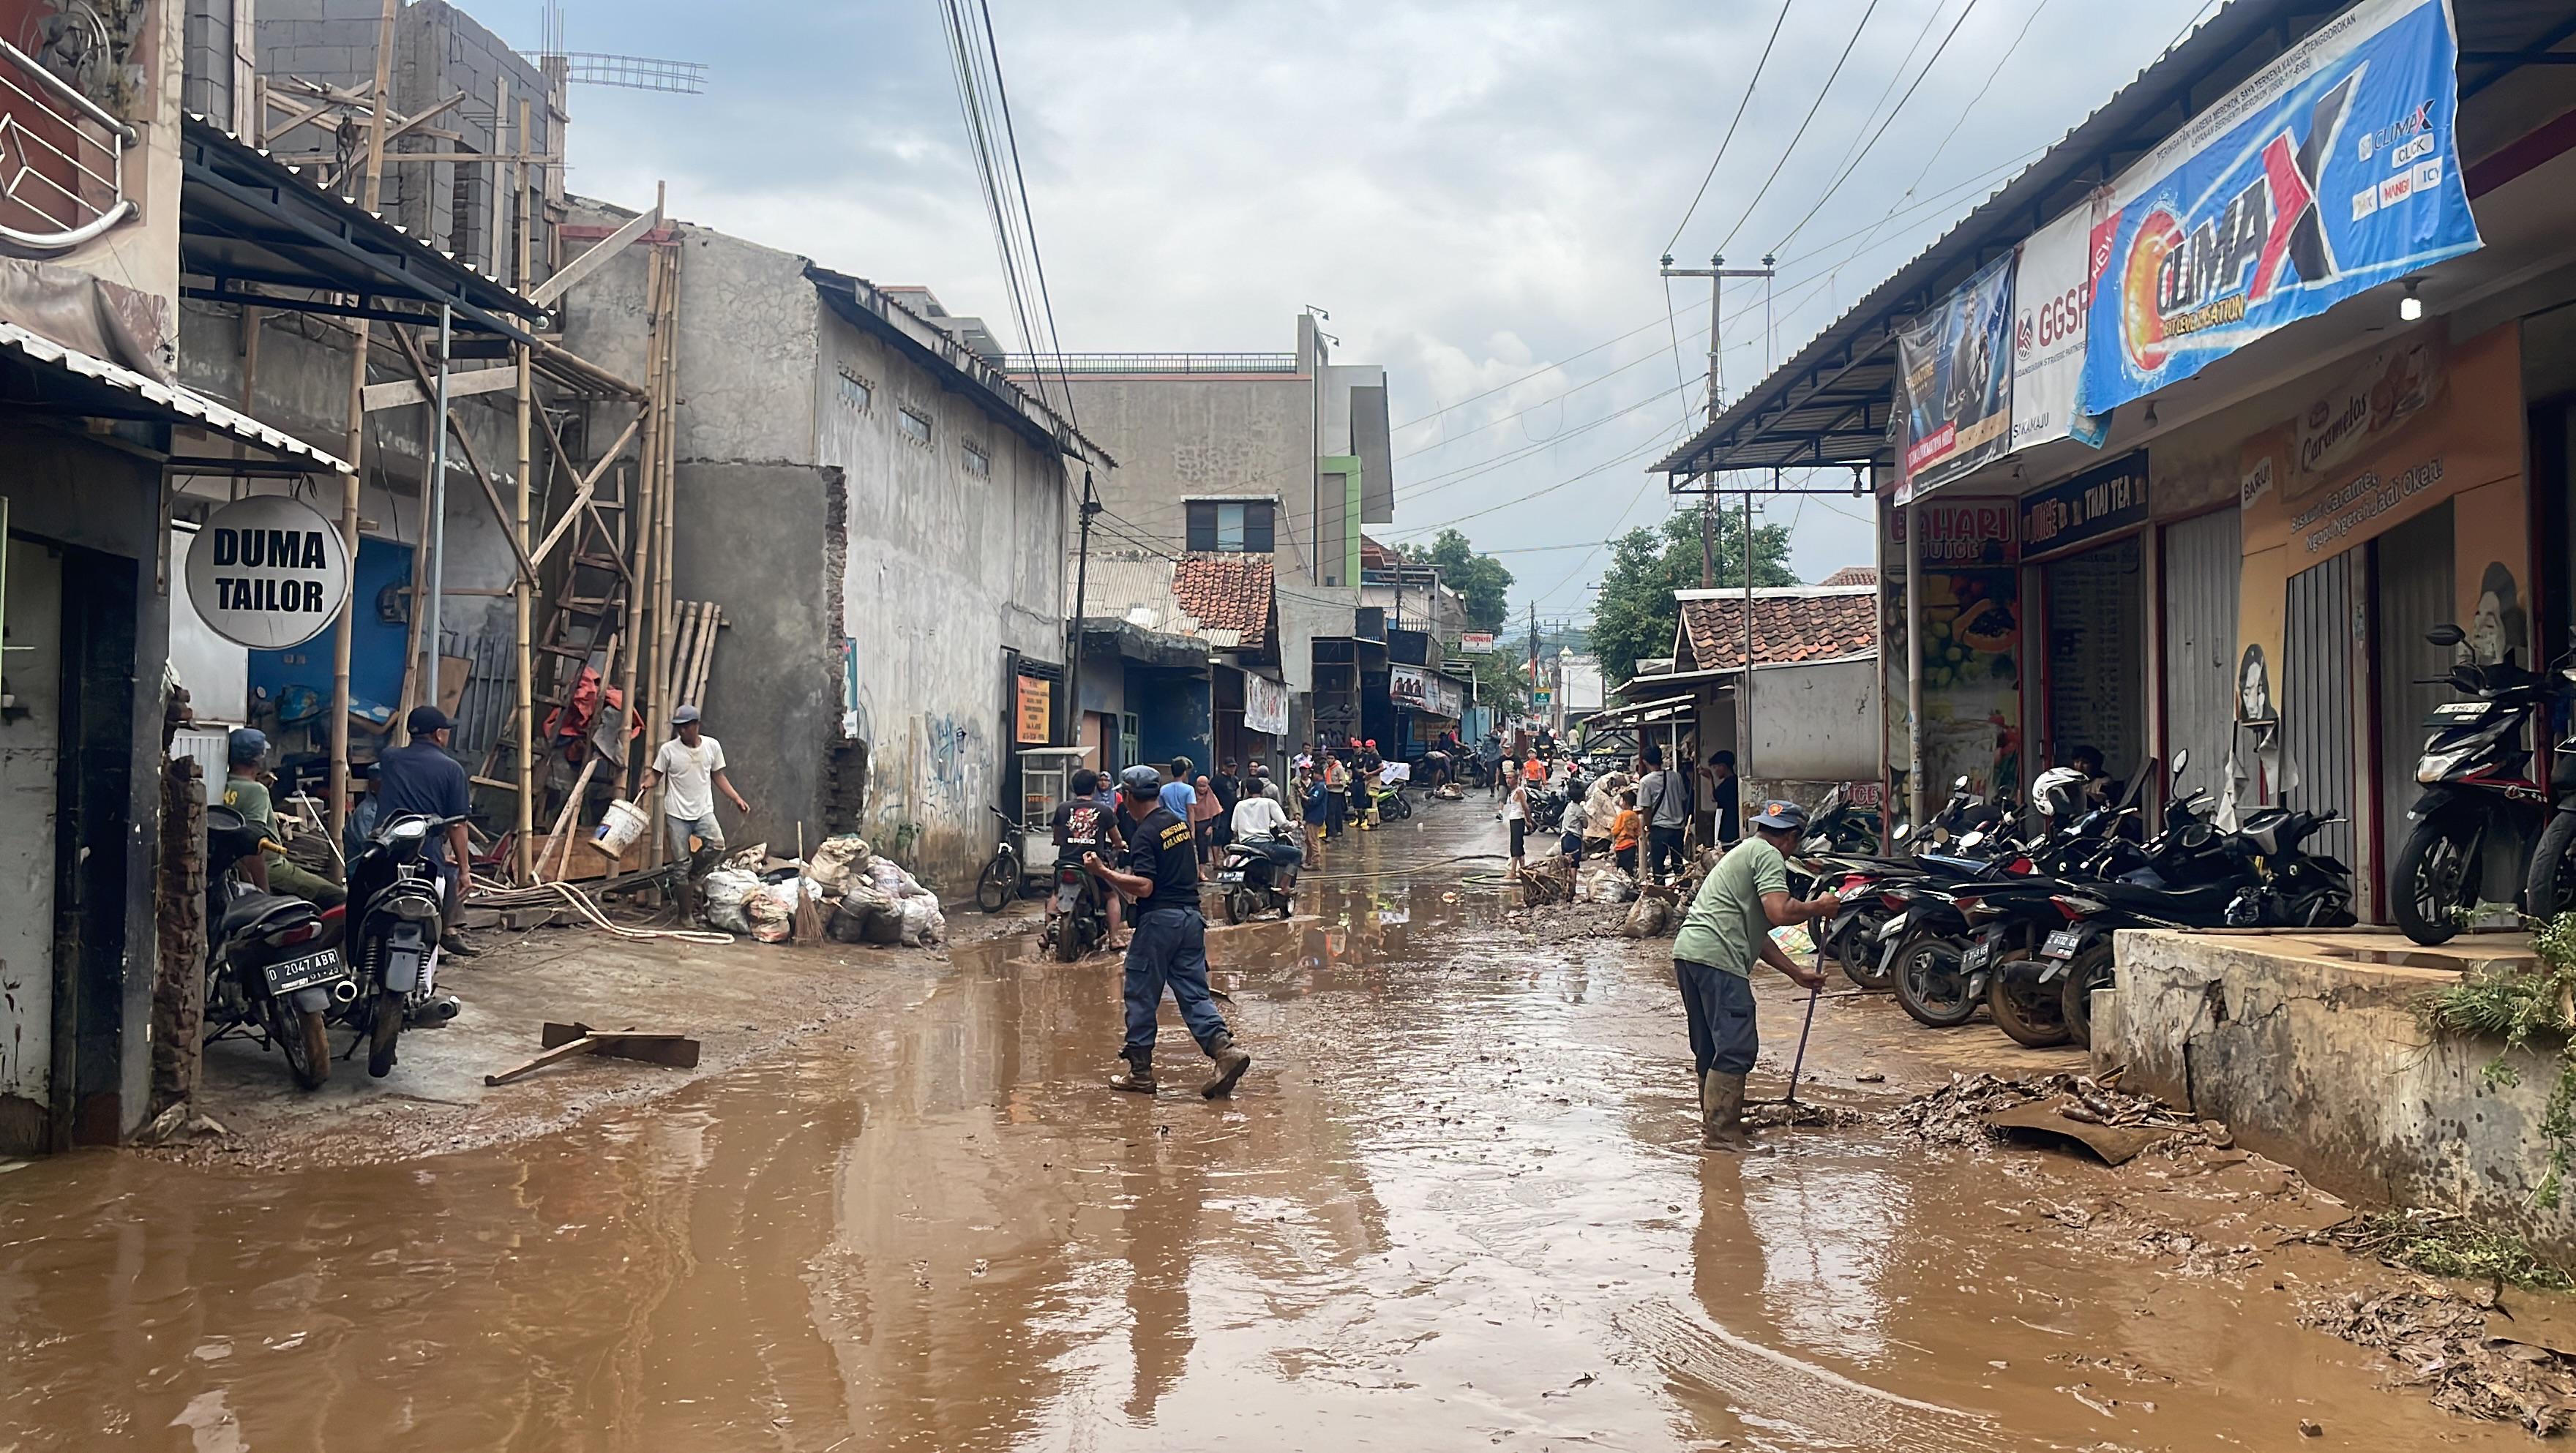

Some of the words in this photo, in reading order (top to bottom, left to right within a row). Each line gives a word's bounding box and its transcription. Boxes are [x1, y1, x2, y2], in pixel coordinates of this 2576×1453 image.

[2374, 99, 2435, 151] CLIMAX
[2155, 63, 2364, 318] CLIMAX
[2302, 393, 2367, 473] Caramelos
[2084, 482, 2108, 520] THAI
[2111, 475, 2130, 511] TEA
[2244, 464, 2272, 502] BARU!
[2368, 478, 2400, 519] Jadi
[213, 527, 327, 570] DUMA
[214, 577, 324, 613] TAILOR
[269, 969, 277, 981] D
[284, 958, 310, 977] 2047
[315, 953, 337, 969] ABR
